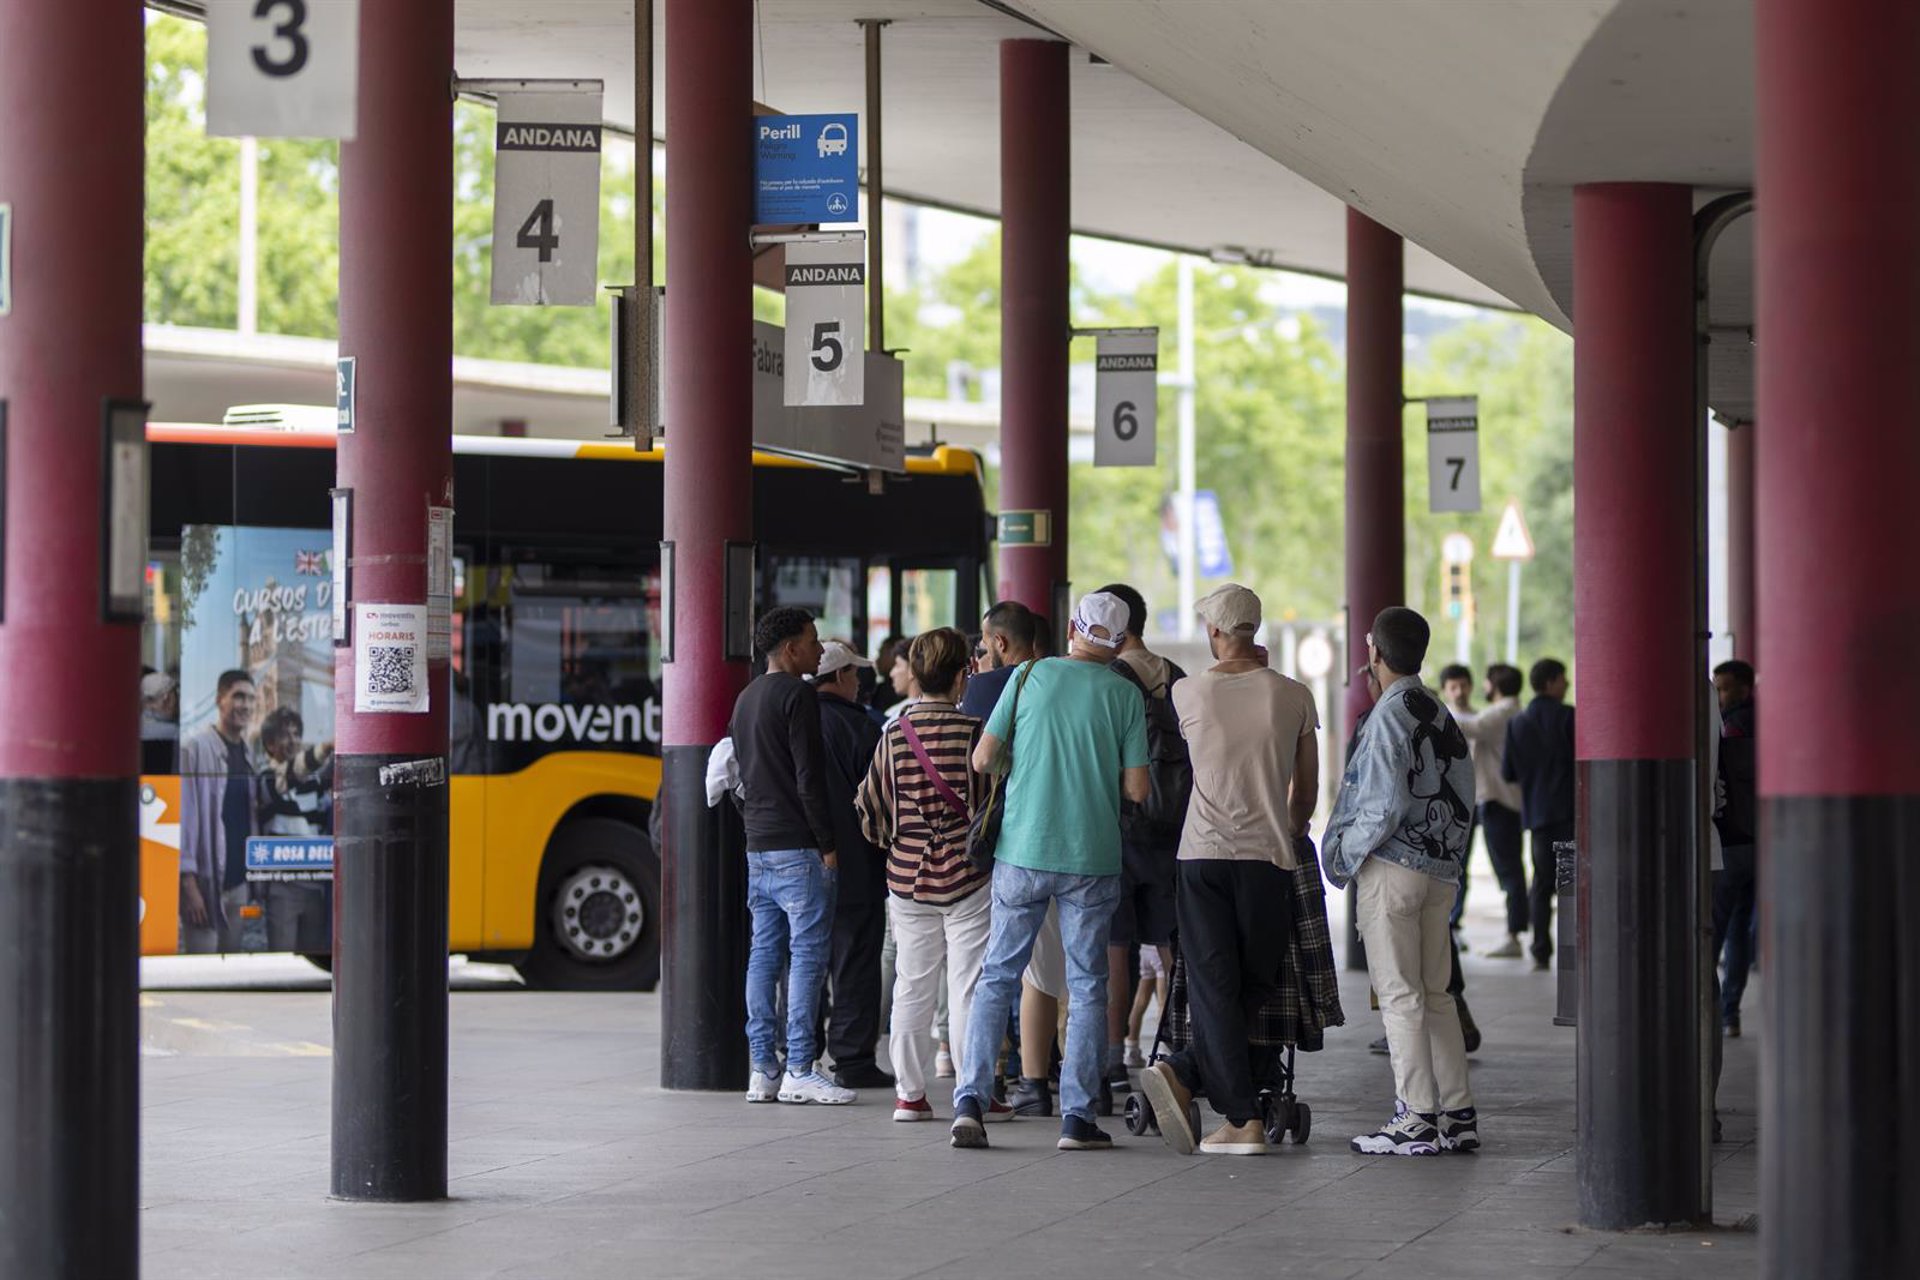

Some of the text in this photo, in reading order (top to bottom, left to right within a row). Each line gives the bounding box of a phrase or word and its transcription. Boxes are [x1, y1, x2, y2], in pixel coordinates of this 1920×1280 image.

[251, 0, 309, 77] 3
[503, 127, 598, 148] ANDANA
[760, 124, 801, 140] Perill
[515, 198, 560, 263] 4
[790, 267, 861, 282] ANDANA
[811, 321, 843, 372] 5
[1099, 356, 1154, 370] ANDANA
[1113, 401, 1138, 441] 6
[1429, 418, 1477, 431] ANDANA
[1446, 457, 1466, 491] 7
[233, 584, 307, 615] CURSOS
[249, 616, 262, 645] A
[368, 631, 415, 641] HORARIS
[487, 697, 661, 742] movent
[273, 845, 305, 862] ROSA
